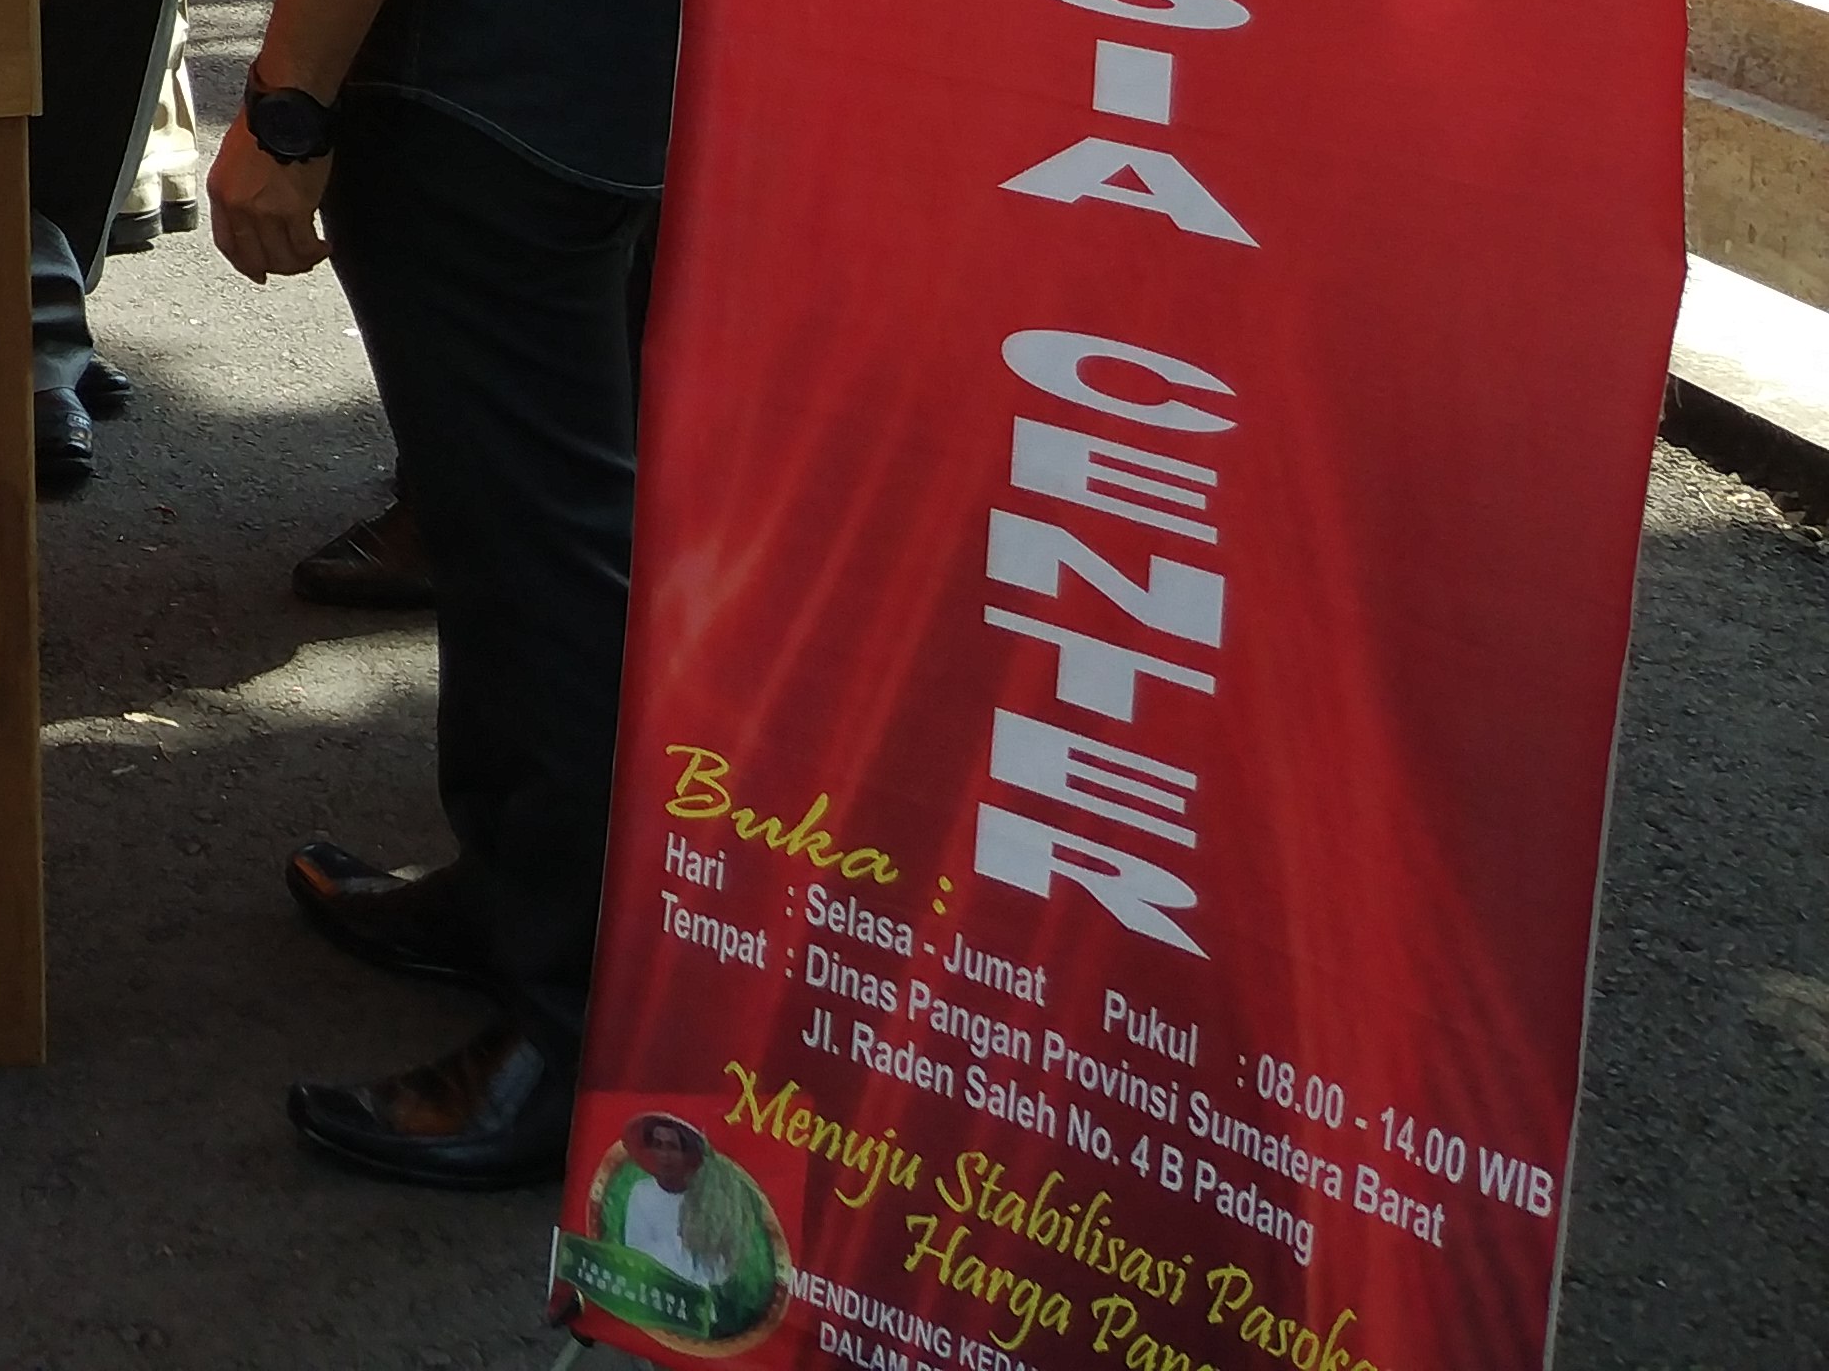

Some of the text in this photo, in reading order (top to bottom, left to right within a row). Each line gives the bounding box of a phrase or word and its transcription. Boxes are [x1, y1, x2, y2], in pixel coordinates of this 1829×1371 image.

[973, 326, 1239, 960] CENTER
[664, 744, 900, 885] Buka
[660, 889, 1446, 1250] Tempat Dinas Pangan Provinsi Sumatera Barat
[664, 831, 1554, 1218] Hari Selasa Jumat Pukul 08.00 14.00 WIB
[801, 1006, 1315, 1267] Jl. Raden Saleh No. 4 B Padang
[722, 1059, 923, 1210] Menuju
[935, 1150, 1195, 1306] Stabilisasi
[904, 1213, 1221, 1371] Harga Pan
[790, 1266, 953, 1359] MENDUKUNG
